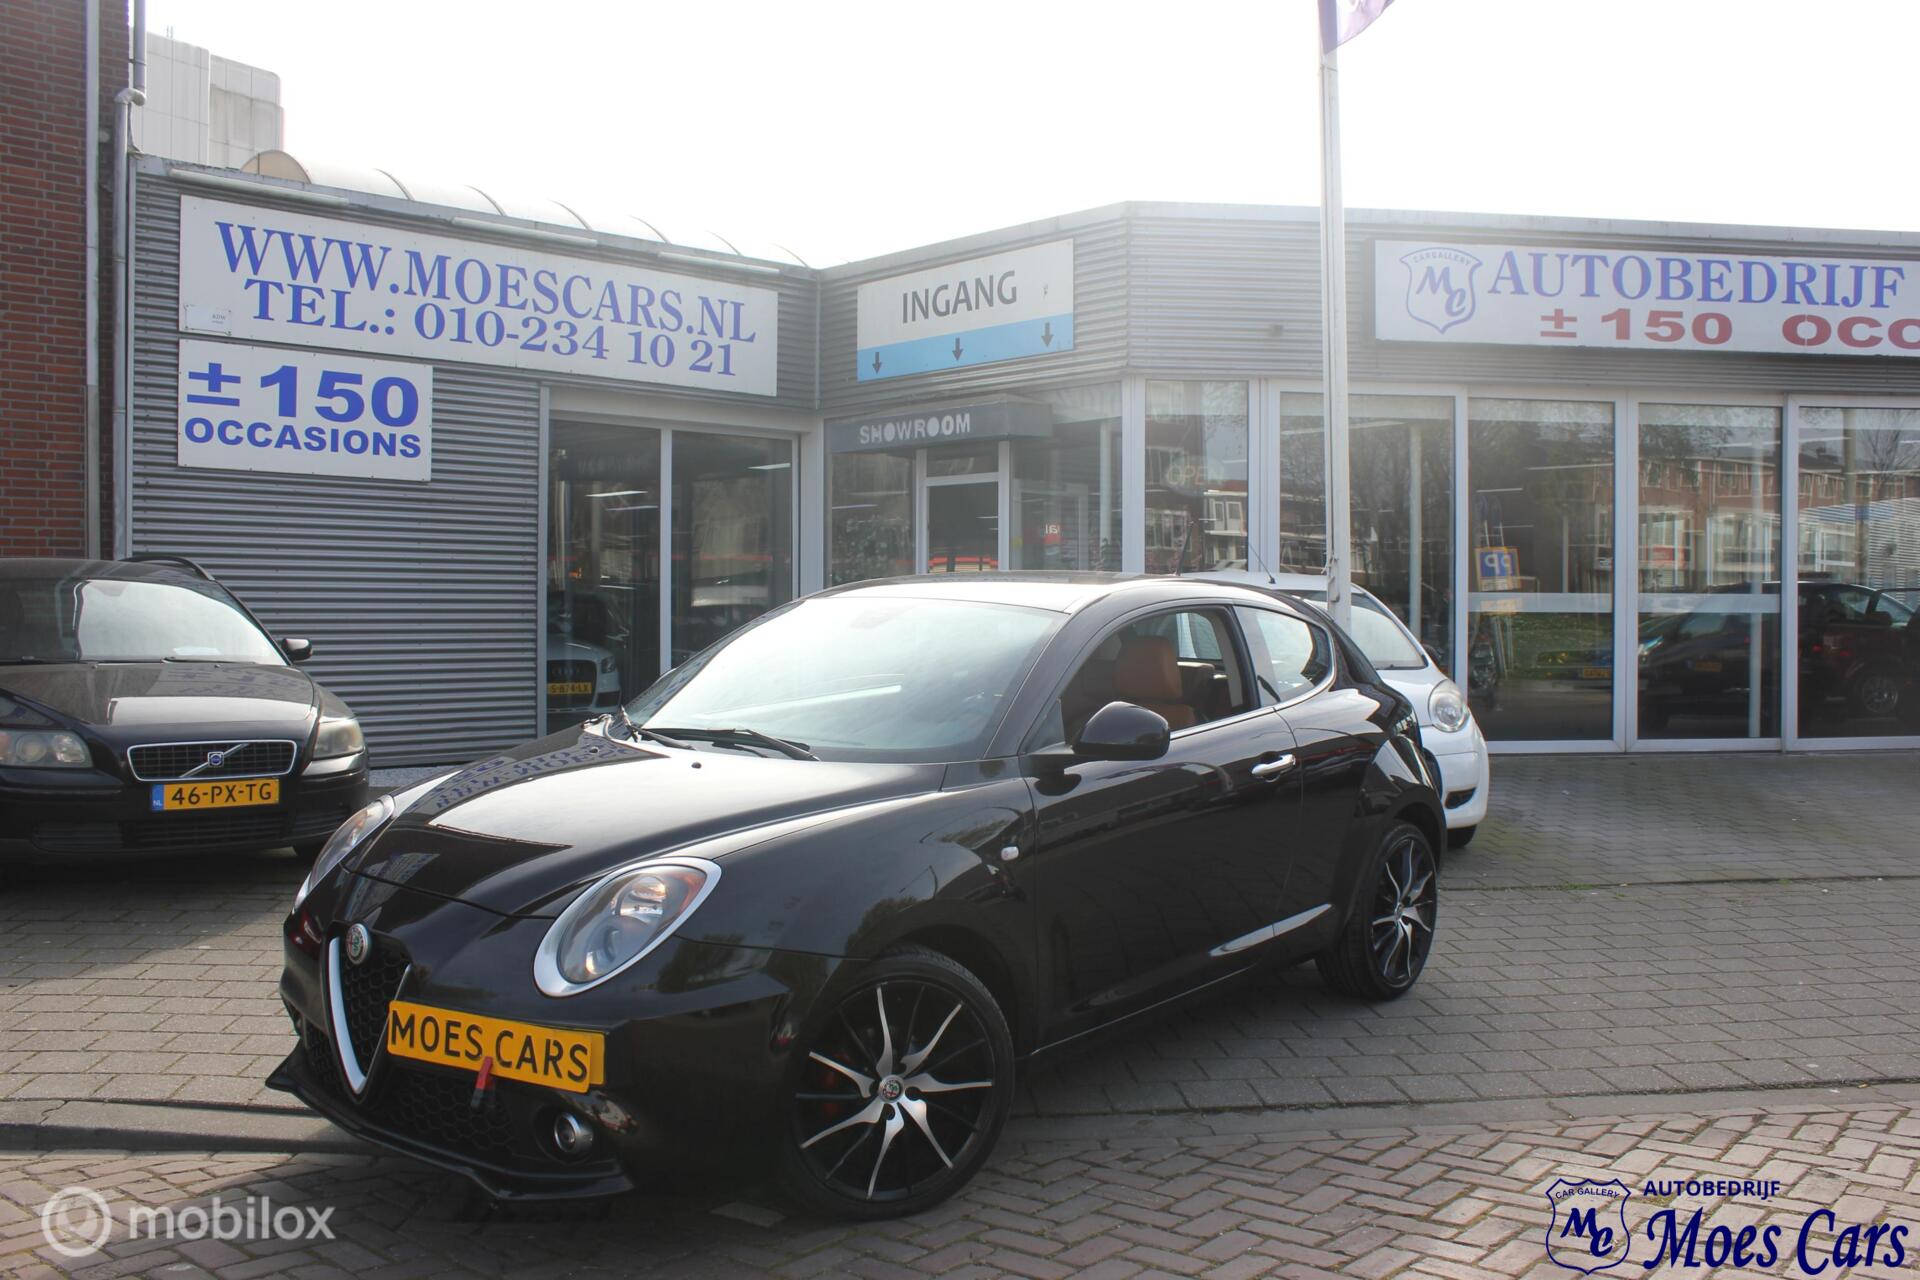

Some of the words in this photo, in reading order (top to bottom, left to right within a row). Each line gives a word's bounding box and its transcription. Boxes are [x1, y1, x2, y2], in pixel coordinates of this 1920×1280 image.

[214, 221, 757, 344] WWW.MOESCARS.NL
[902, 270, 1018, 325] INGANG
[1487, 249, 1906, 309] AUTOBEDRIJF
[244, 278, 396, 336] TEL.:
[414, 303, 610, 360] 010-234
[627, 331, 676, 368] 10
[689, 340, 738, 377] 21
[184, 416, 421, 459] OCCASIONS
[859, 413, 971, 444] SHOWROOM
[171, 782, 272, 806] 46-PX-TG
[390, 1009, 484, 1062] MOES
[494, 1029, 589, 1083] CARS
